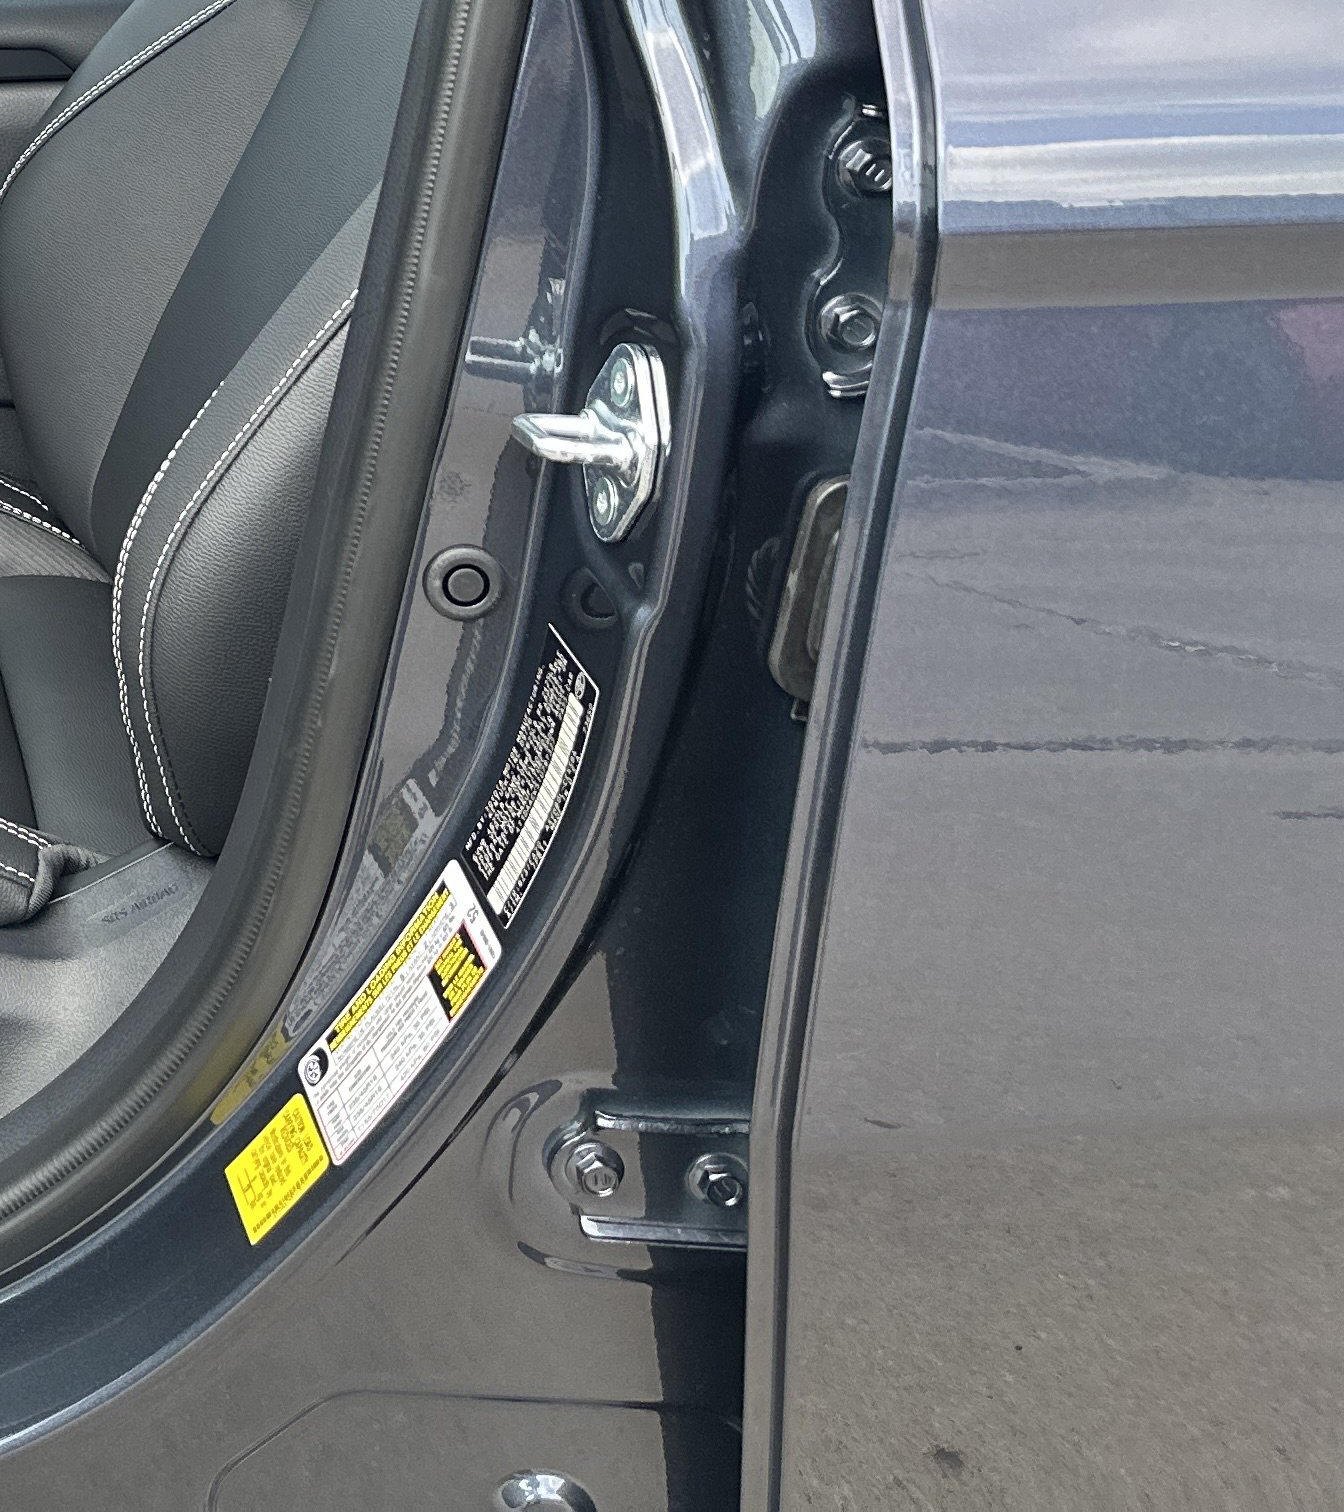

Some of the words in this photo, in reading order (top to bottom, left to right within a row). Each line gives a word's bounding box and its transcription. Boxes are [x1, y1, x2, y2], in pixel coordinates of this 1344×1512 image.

[466, 903, 479, 924] 52
[349, 988, 366, 1014] AND
[366, 953, 396, 995] LOADING
[393, 891, 441, 954] INFORMATION
